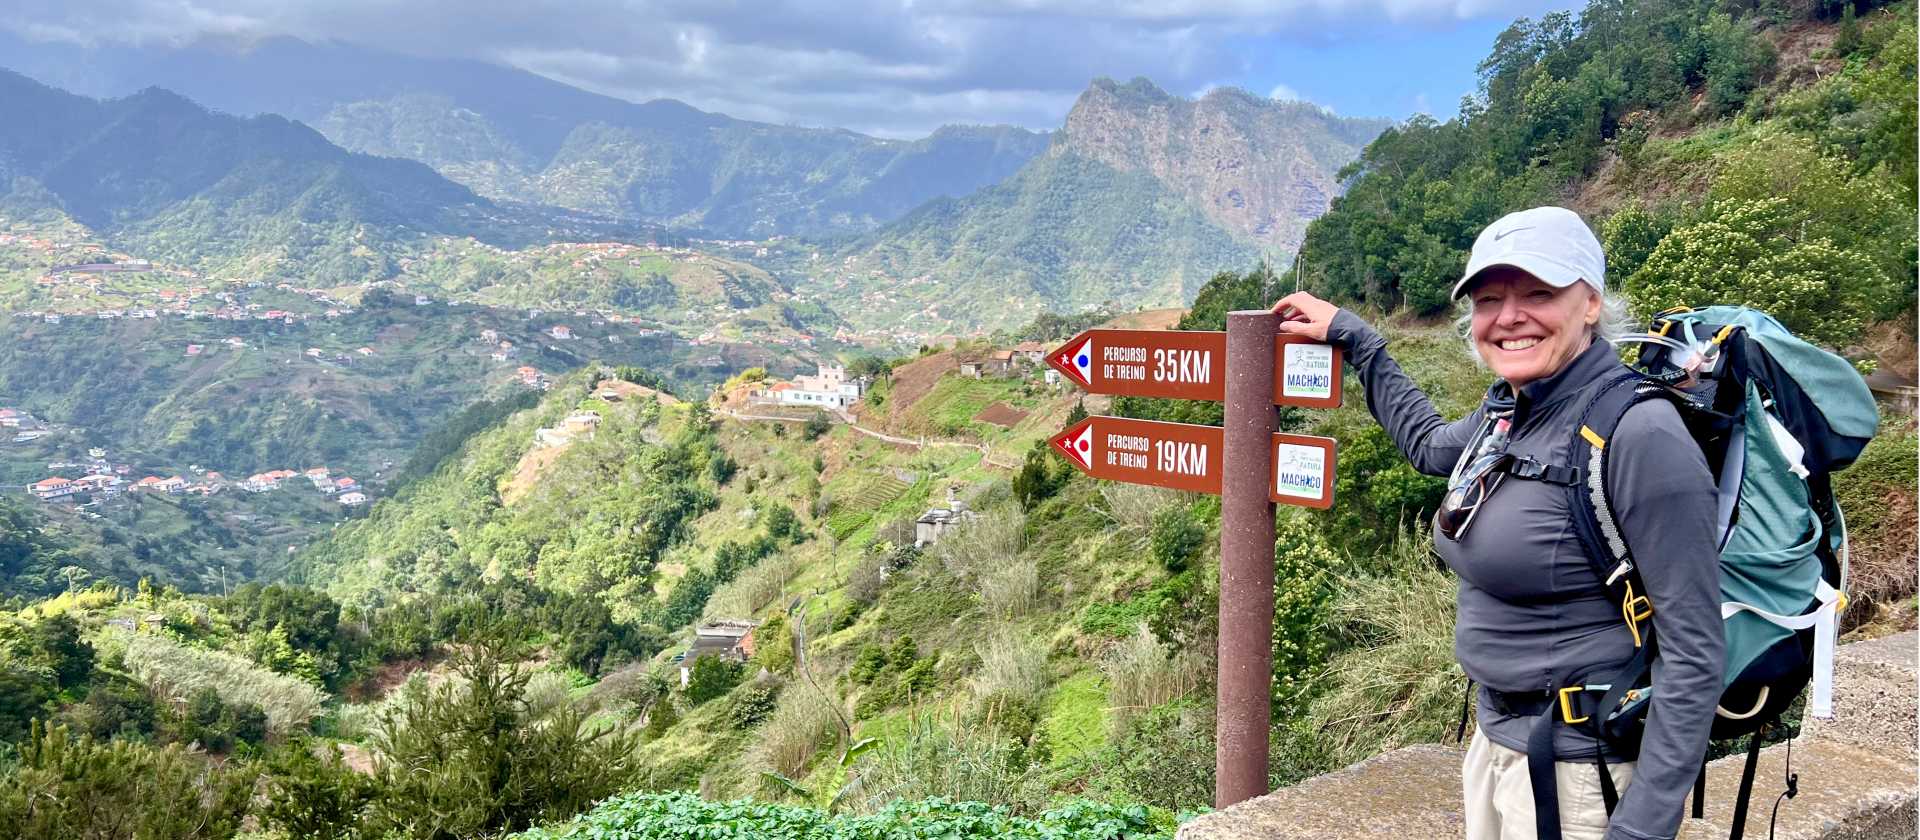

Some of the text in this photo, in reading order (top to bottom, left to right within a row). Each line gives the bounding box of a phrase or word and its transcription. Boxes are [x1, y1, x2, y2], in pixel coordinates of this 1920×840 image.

[1103, 346, 1147, 362] PERCURSO
[1103, 364, 1146, 380] DE TREINO
[1153, 348, 1211, 384] 35KM
[1287, 373, 1329, 388] MACHICO
[1107, 433, 1149, 452] PERCURSO
[1107, 451, 1148, 469] DE TREINO
[1155, 439, 1208, 477] 19KM
[1281, 471, 1321, 489] MACHICO
